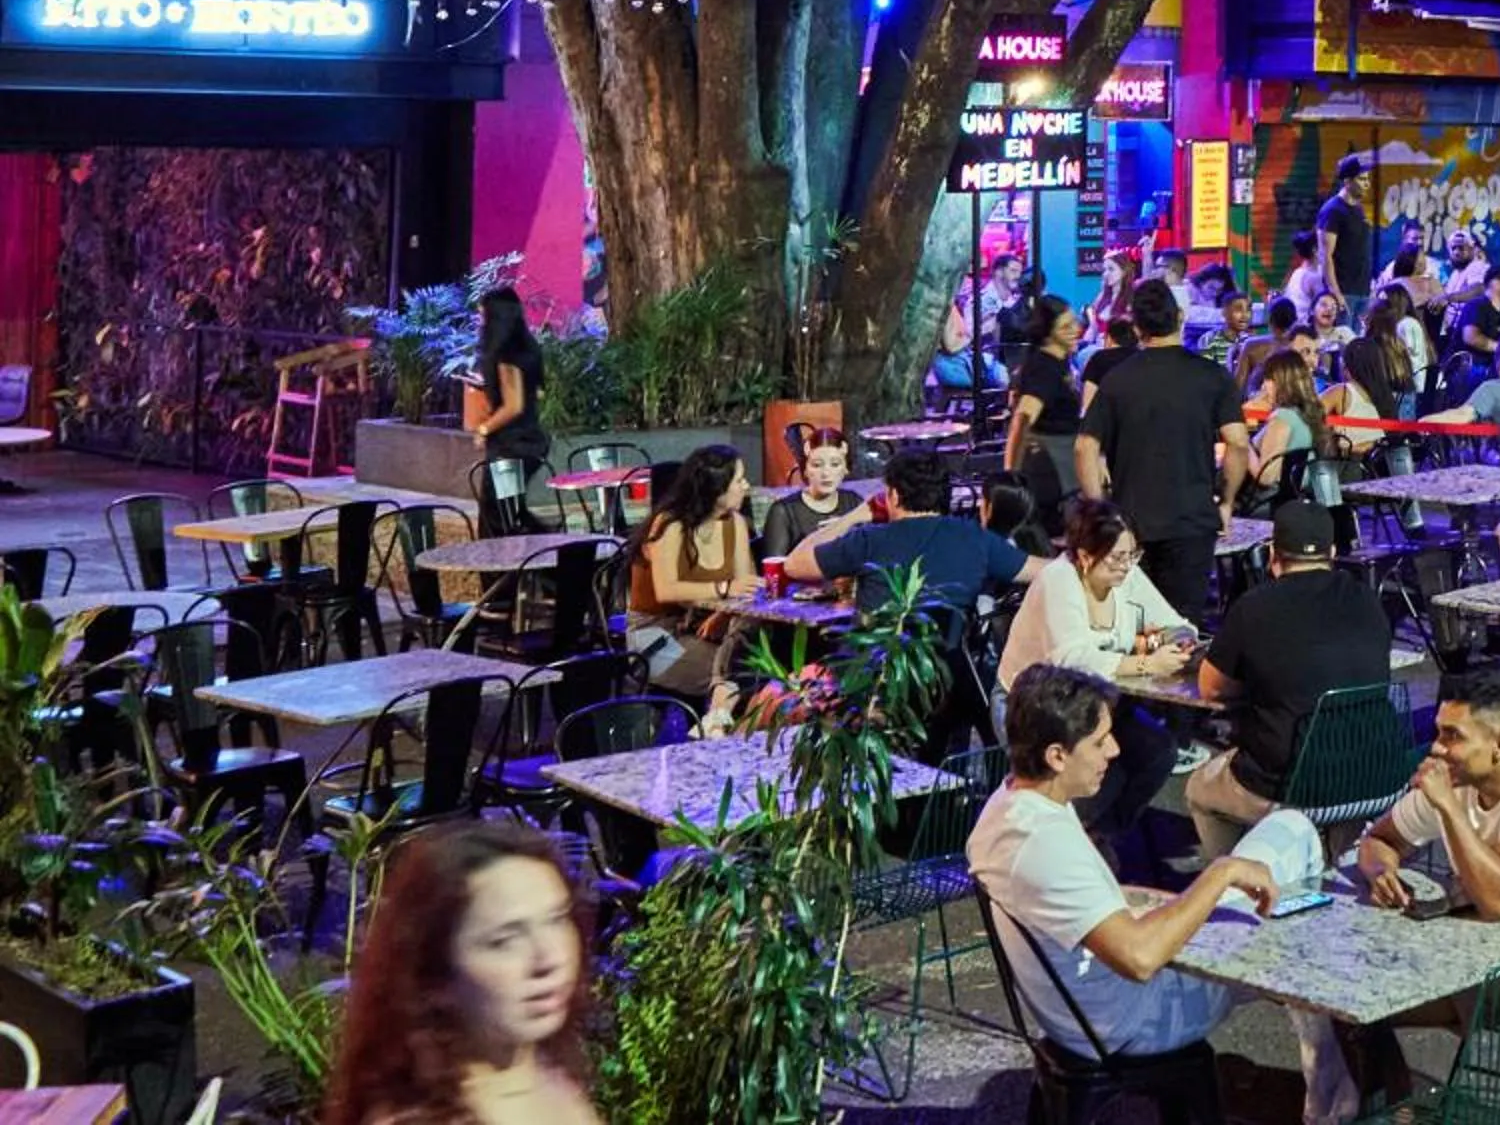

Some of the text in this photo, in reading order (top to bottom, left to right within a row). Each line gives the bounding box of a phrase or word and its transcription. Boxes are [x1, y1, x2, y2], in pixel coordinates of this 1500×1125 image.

[997, 35, 1063, 60] HOUSE
[1114, 80, 1166, 104] HOUSE
[960, 111, 1005, 136] UNA
[1005, 138, 1033, 158] EN
[960, 155, 1081, 191] MEDELLÍN
